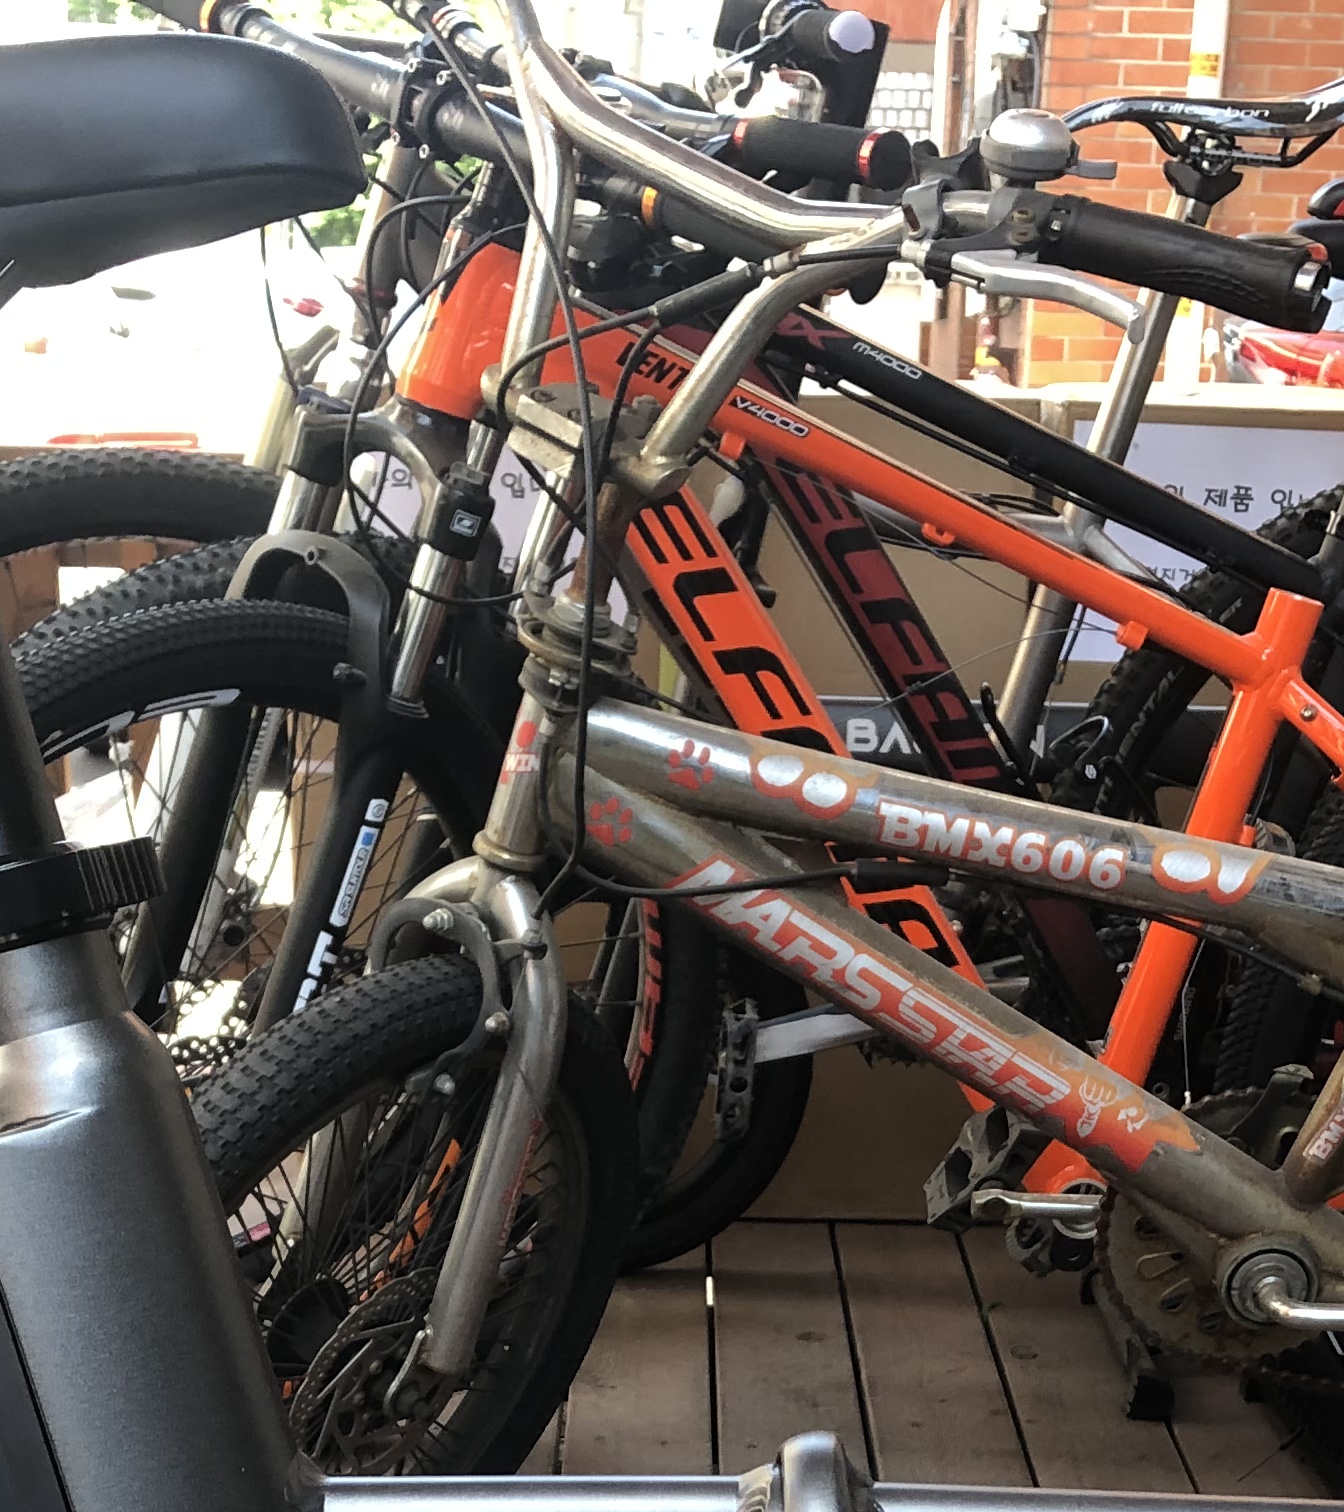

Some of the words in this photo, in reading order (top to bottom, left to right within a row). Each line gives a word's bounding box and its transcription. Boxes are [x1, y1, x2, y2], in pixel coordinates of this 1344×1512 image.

[728, 395, 809, 437] V4000
[1203, 484, 1255, 513] 제품
[878, 799, 1127, 891] BMX606
